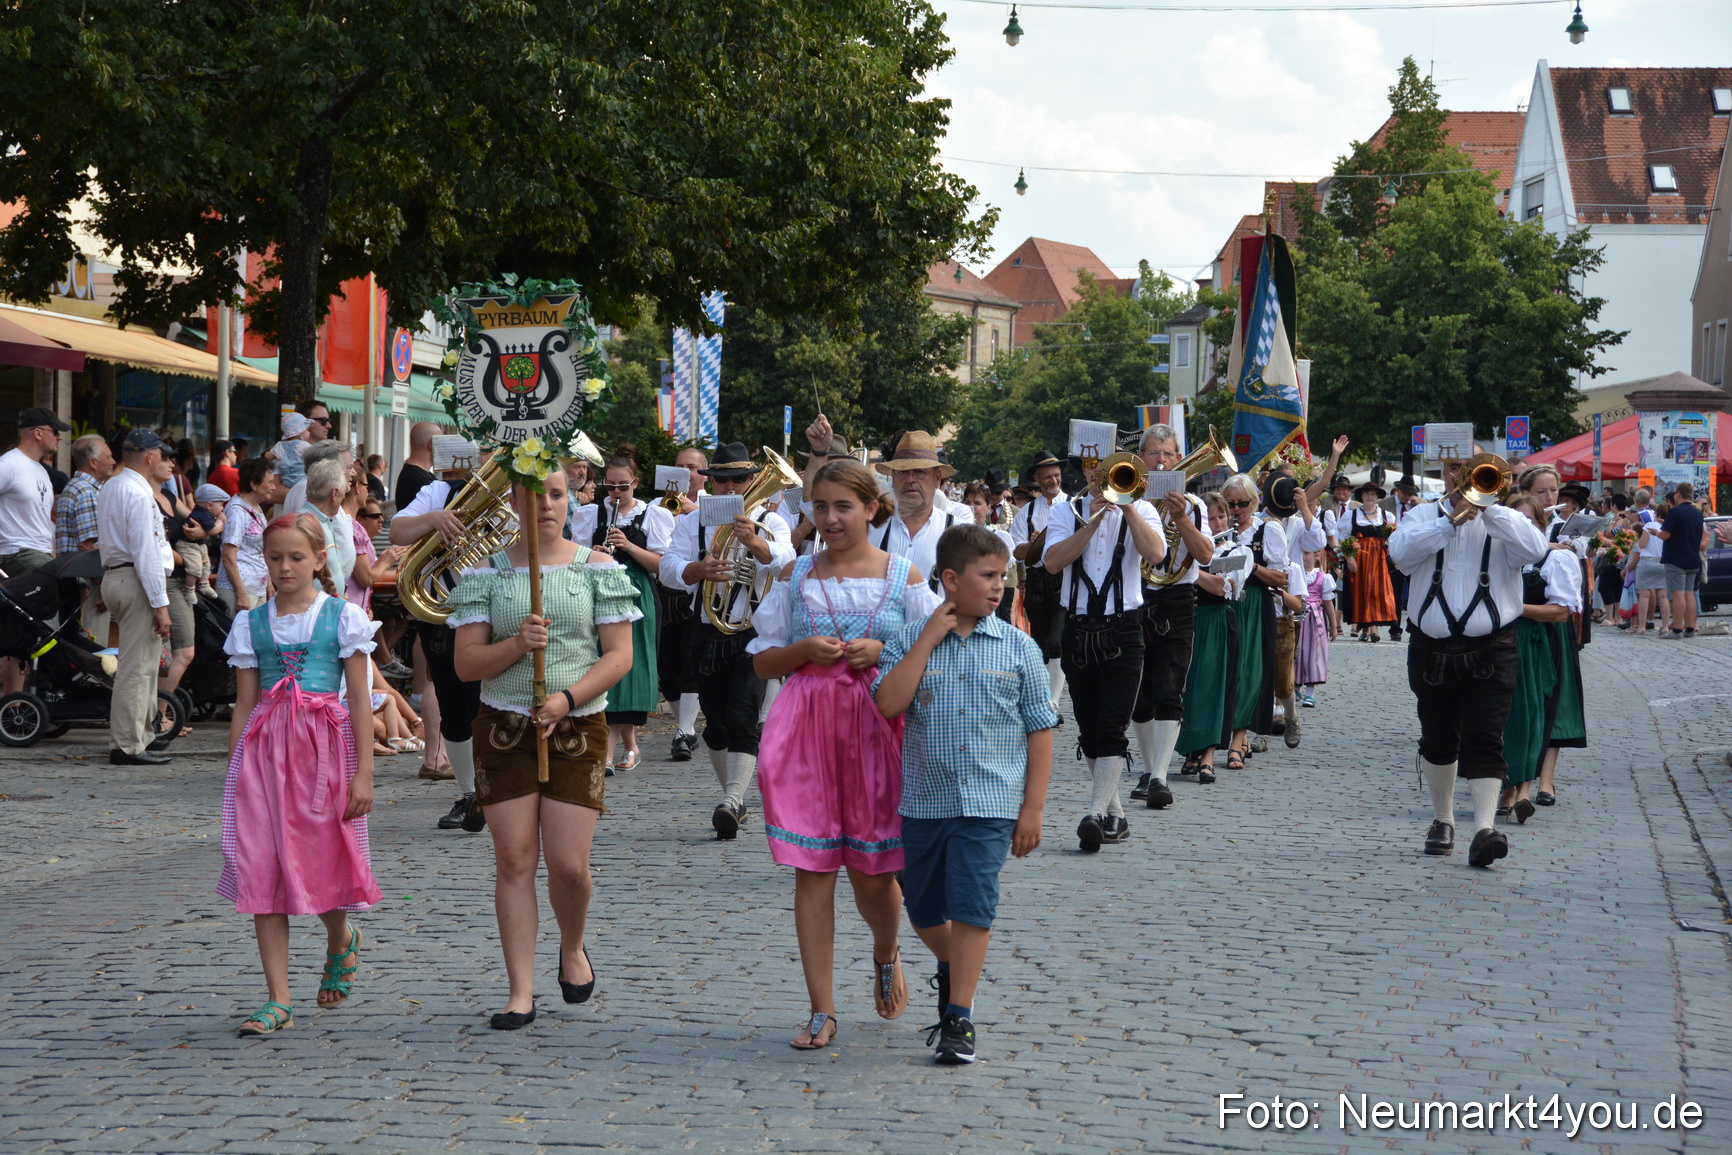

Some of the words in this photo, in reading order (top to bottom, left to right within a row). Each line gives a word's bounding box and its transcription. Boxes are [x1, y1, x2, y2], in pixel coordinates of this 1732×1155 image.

[477, 310, 559, 327] PYRBAUM
[458, 353, 501, 437] MUSIKVERN
[502, 425, 528, 443] DER
[1507, 440, 1527, 448] TAXI
